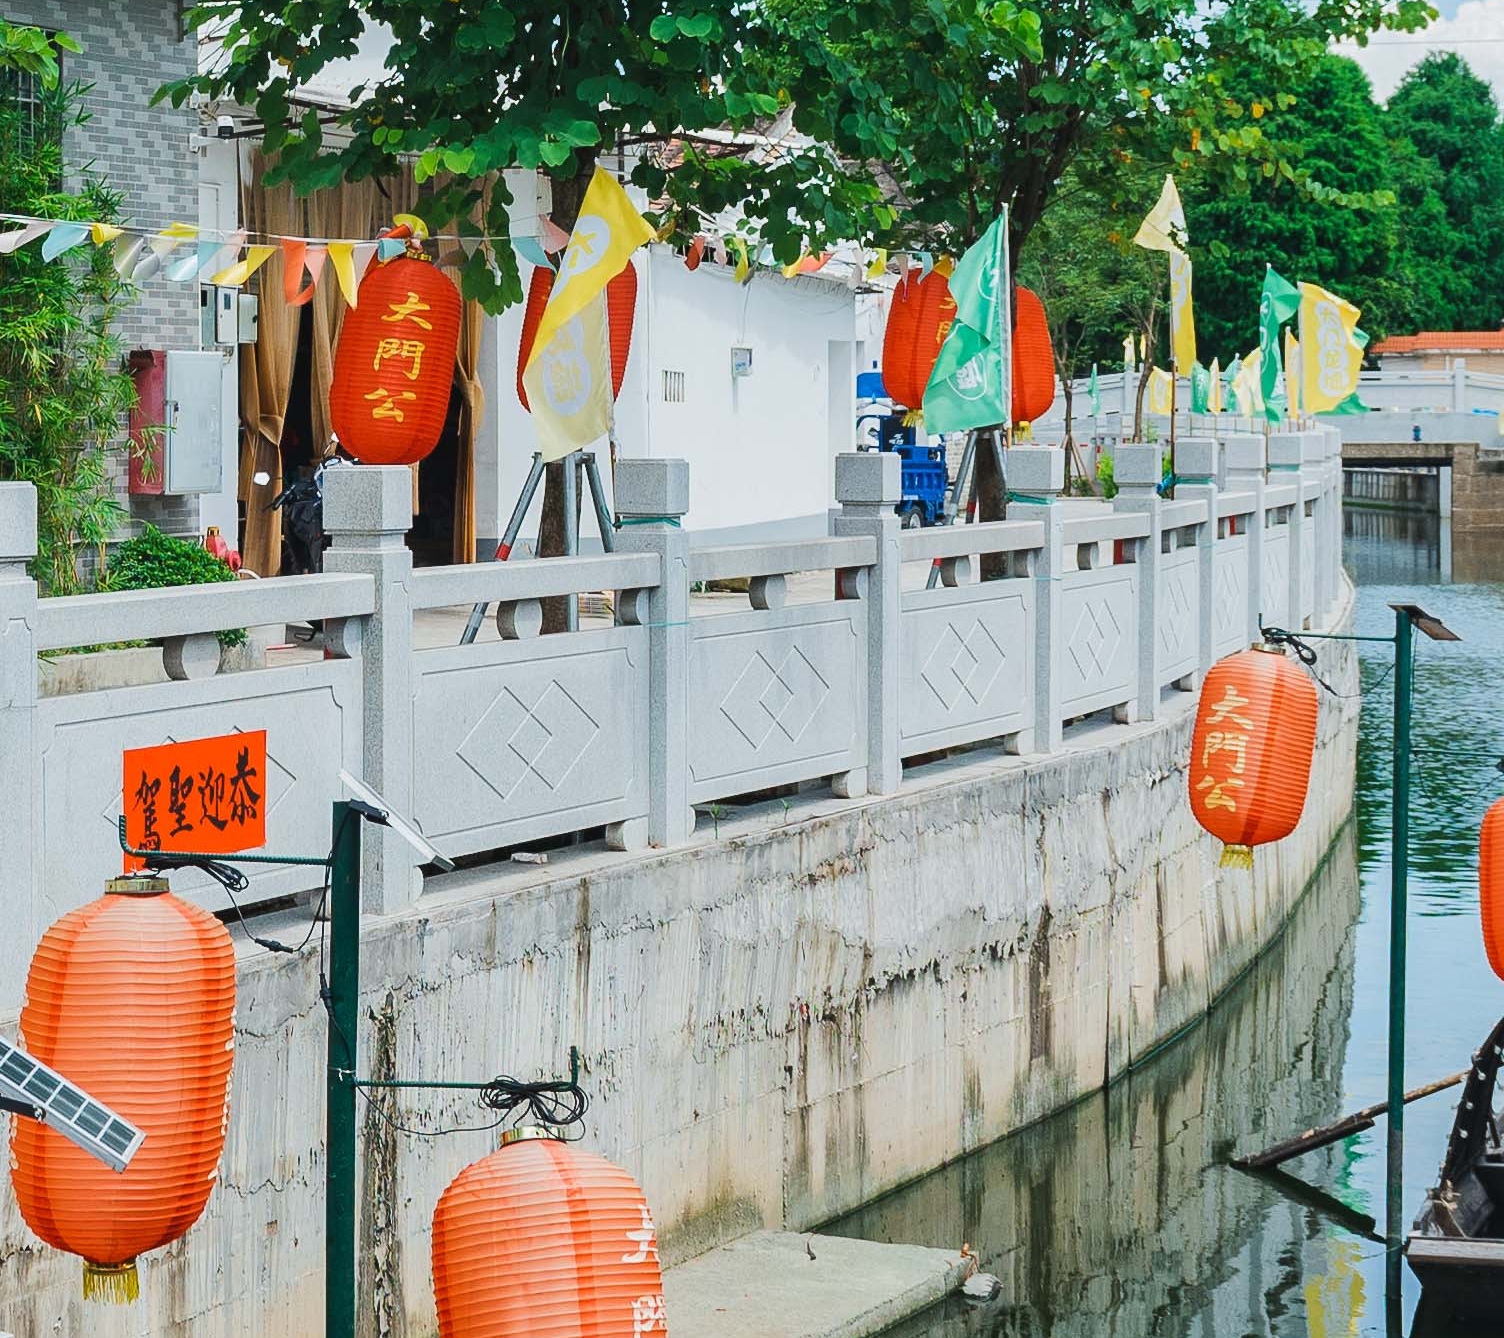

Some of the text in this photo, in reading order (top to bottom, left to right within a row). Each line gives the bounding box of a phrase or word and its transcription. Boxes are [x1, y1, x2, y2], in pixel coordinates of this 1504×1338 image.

[364, 291, 433, 423] 大門公
[1195, 684, 1254, 813] 大門公
